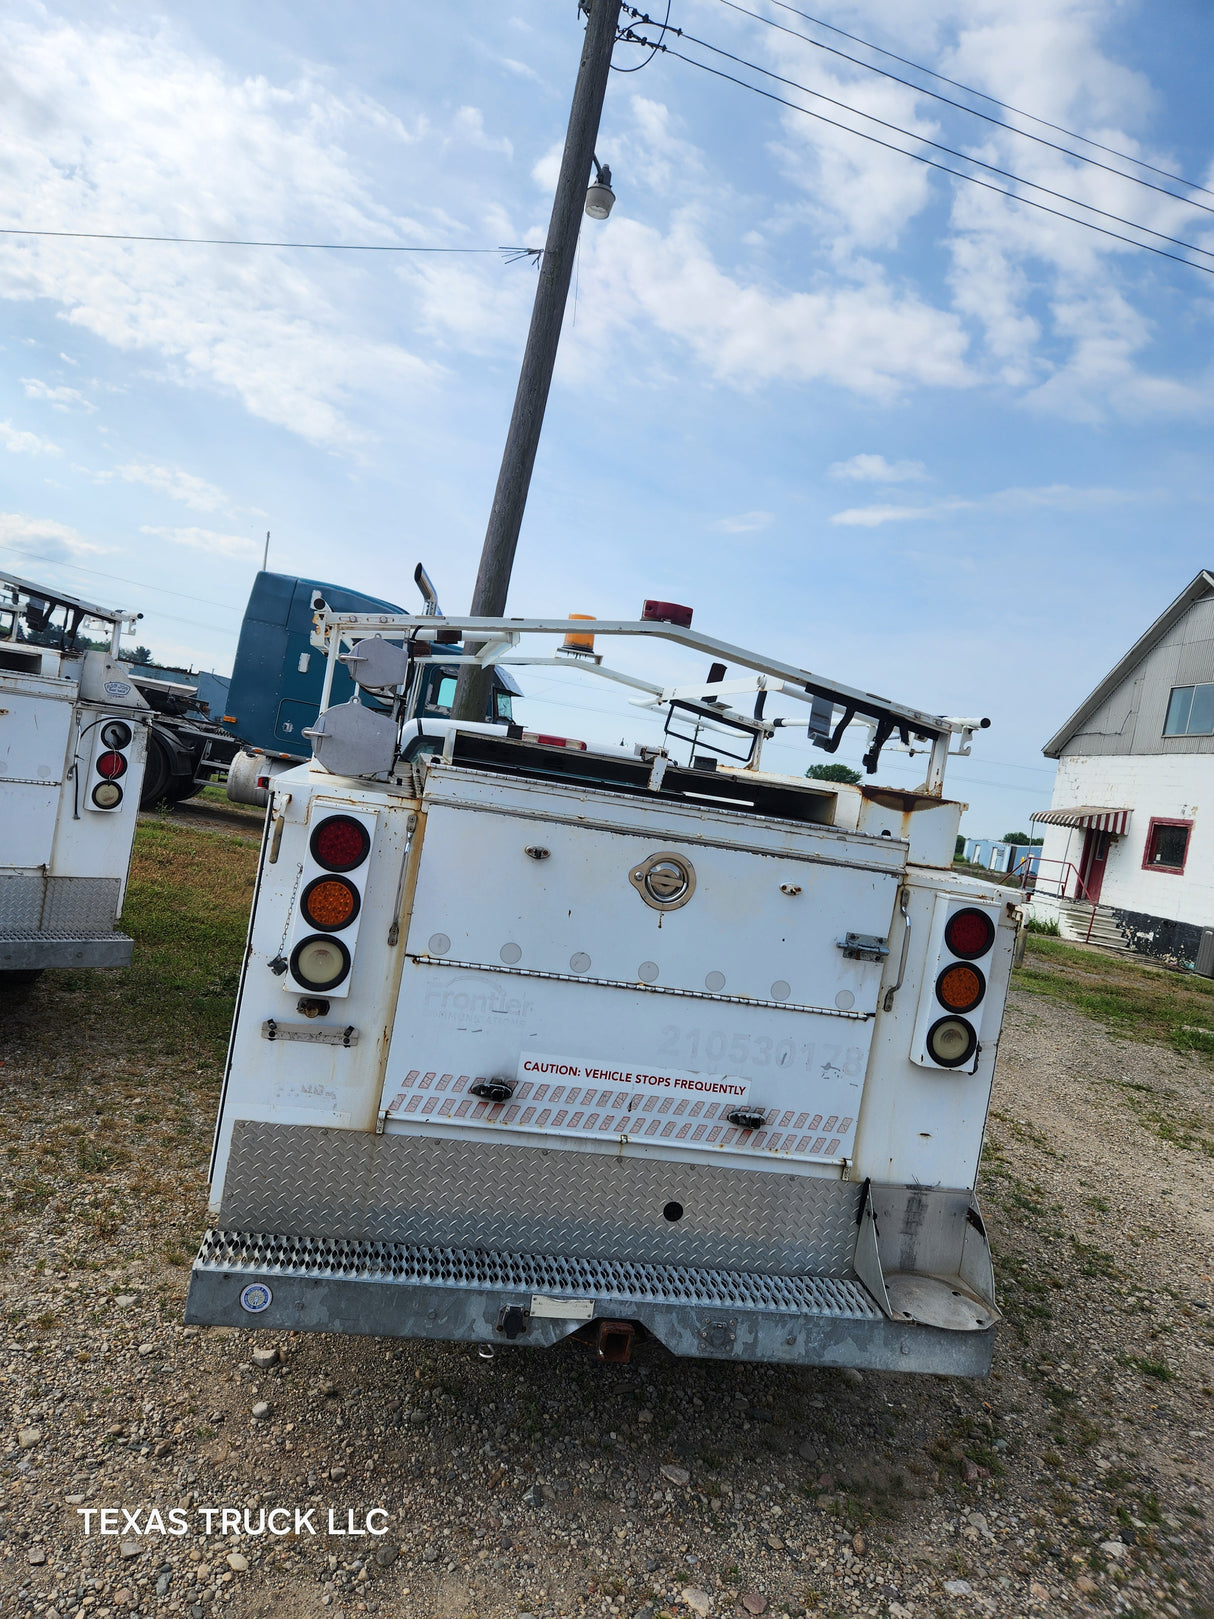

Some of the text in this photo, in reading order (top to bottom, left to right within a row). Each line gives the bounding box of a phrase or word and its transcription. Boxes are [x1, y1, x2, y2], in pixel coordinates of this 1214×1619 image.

[424, 981, 535, 1017] Frontier
[656, 1024, 864, 1077] 210530178
[523, 1060, 747, 1096] CAUTION: VEHICLE STOPS FREQUENTLY
